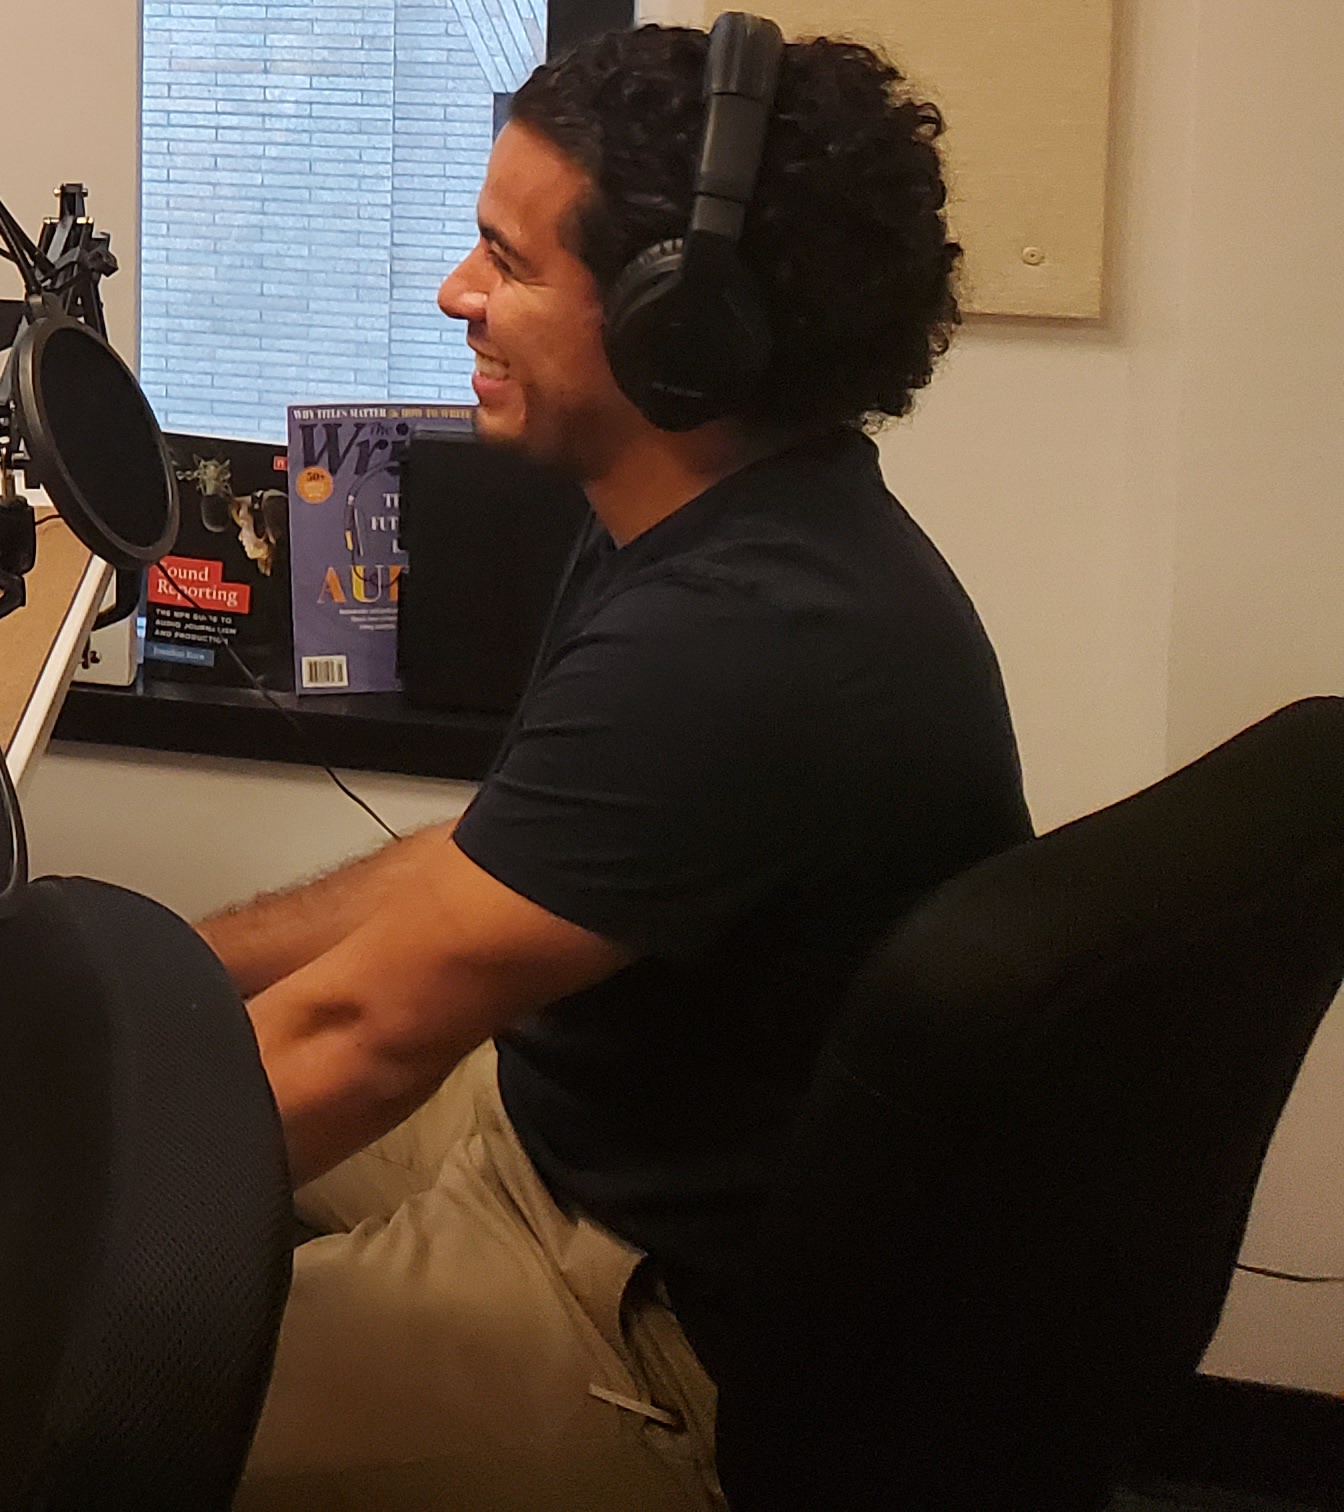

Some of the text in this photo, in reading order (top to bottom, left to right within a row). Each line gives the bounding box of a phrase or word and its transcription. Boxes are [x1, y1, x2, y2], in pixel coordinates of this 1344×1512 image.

[368, 421, 392, 437] The
[157, 578, 238, 608] Reporting
[155, 608, 171, 618] THE
[174, 610, 191, 620] NPR
[221, 616, 233, 625] TO
[155, 618, 182, 629] AUDIO
[154, 628, 173, 638] AND
